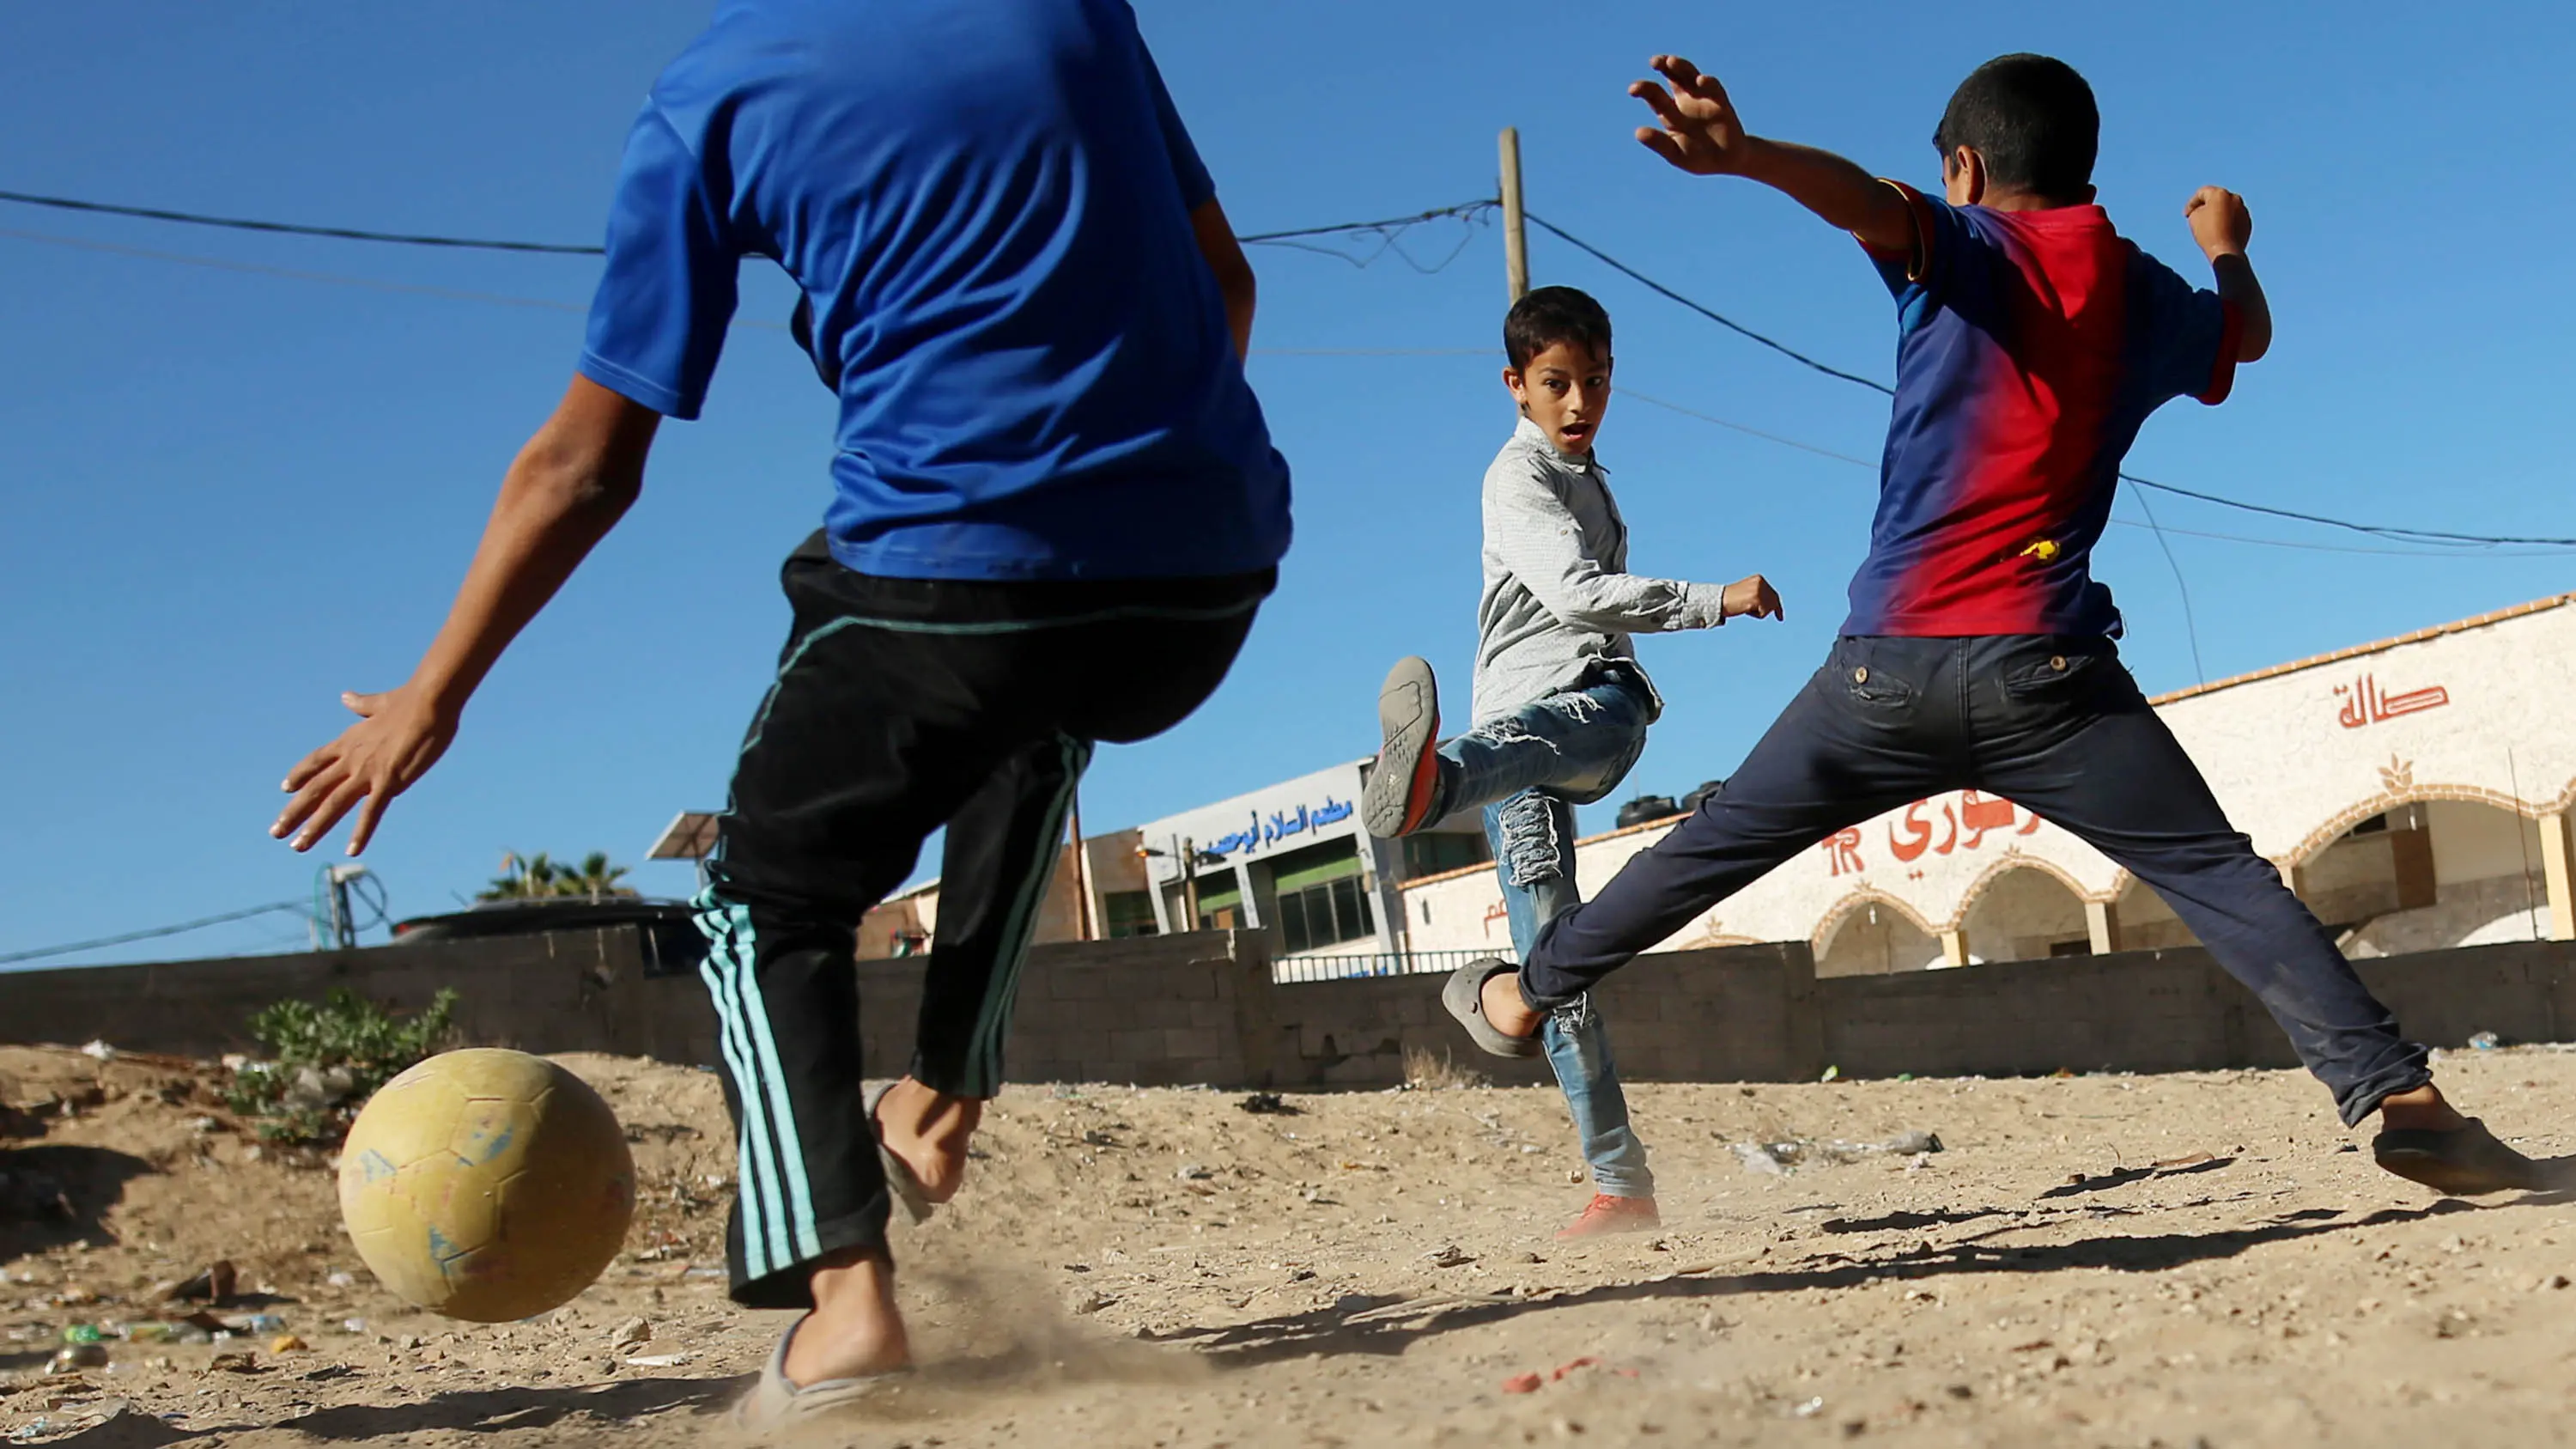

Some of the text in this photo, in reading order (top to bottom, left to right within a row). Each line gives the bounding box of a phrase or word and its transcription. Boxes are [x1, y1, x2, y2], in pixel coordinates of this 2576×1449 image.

[2333, 673, 2450, 729] صالة
[1264, 804, 1309, 849] السلام
[1310, 795, 1353, 837] مطعم
